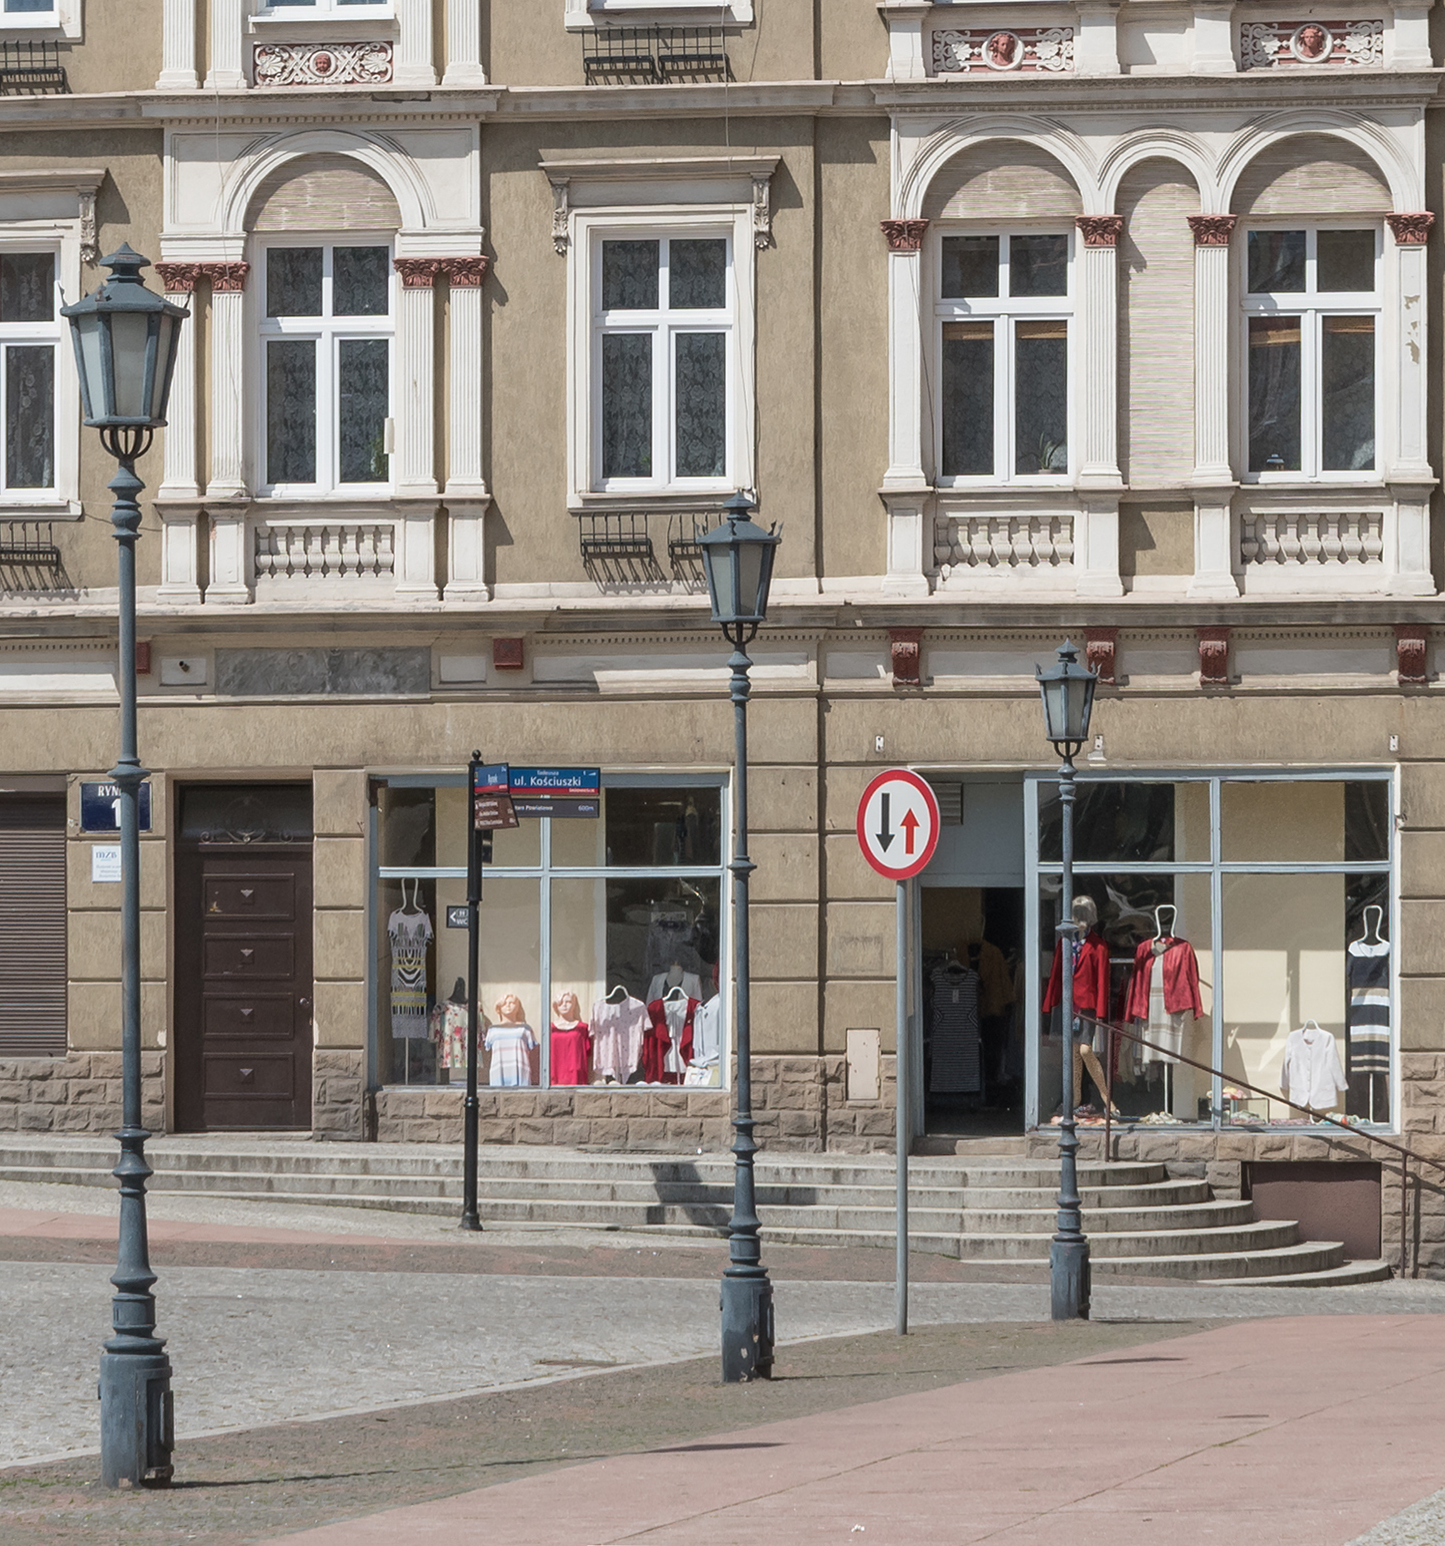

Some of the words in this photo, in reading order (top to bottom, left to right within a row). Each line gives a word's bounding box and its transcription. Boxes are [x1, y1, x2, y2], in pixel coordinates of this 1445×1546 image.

[514, 777, 528, 787] ul.
[530, 775, 582, 787] Kościuszki
[97, 785, 122, 797] RYN
